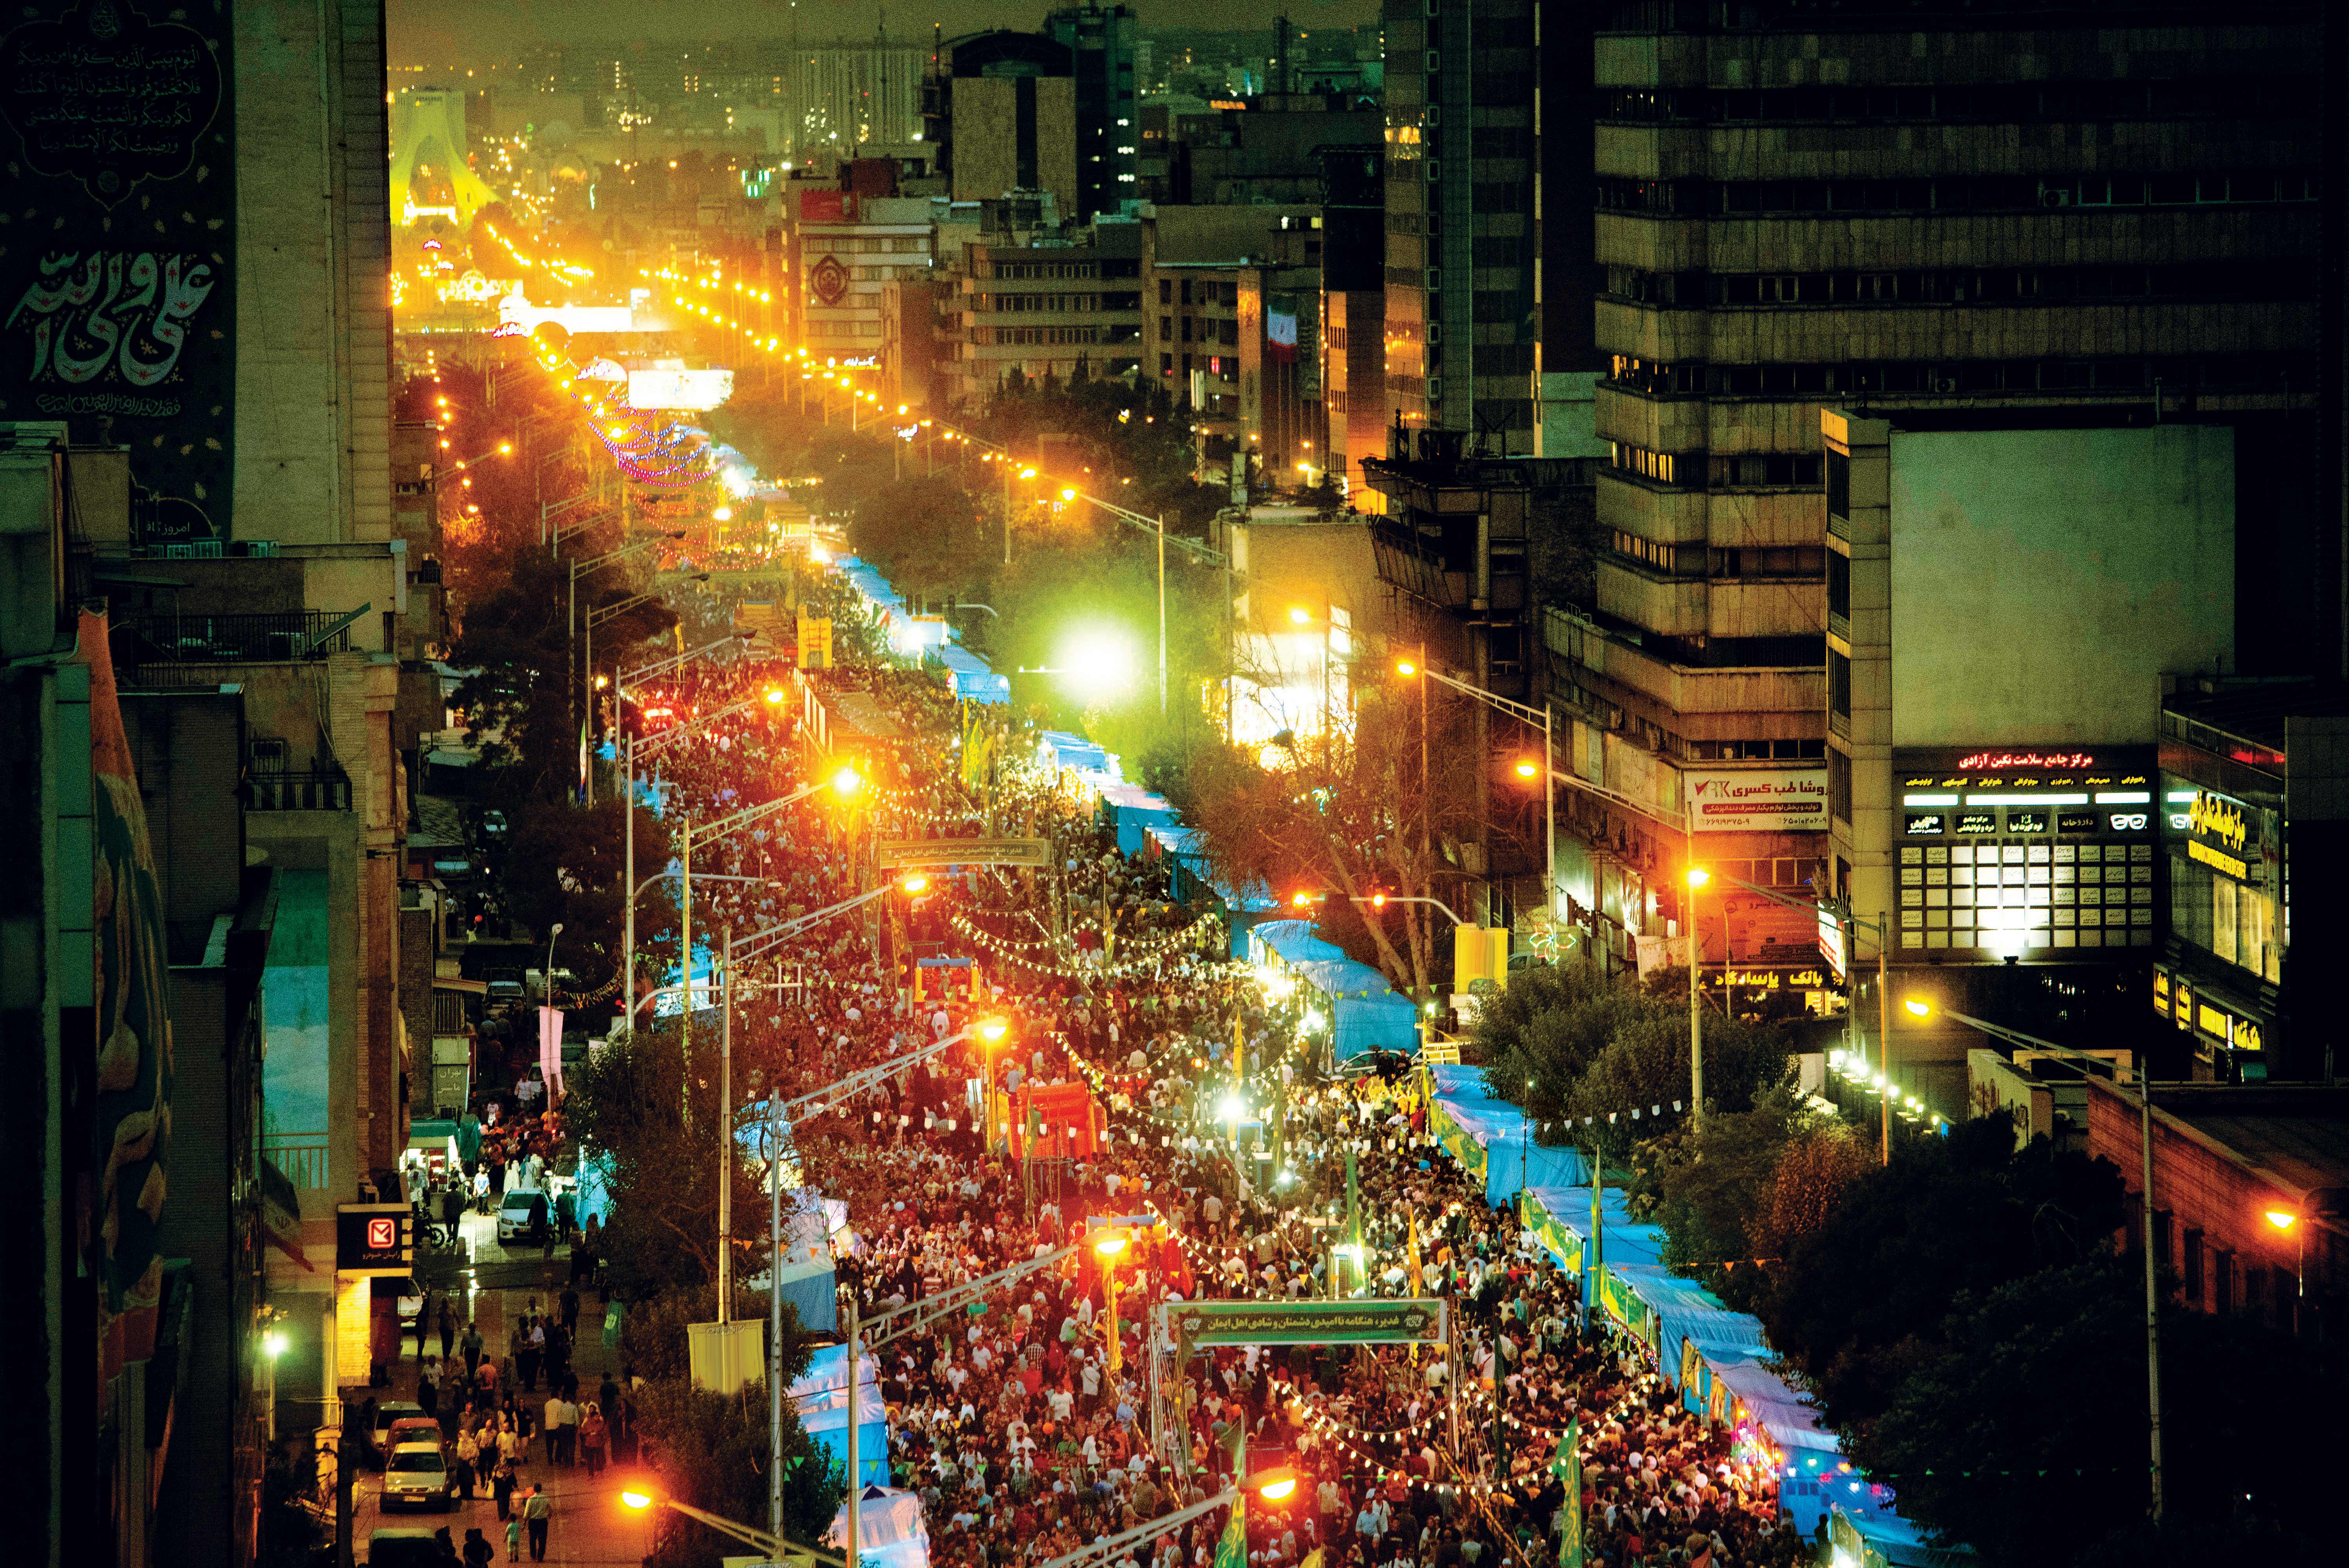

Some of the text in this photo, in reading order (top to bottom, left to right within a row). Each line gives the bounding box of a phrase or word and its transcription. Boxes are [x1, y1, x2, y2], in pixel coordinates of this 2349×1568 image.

[1959, 753, 2092, 768] مرکز جامع سلامت نگین آزادی
[1732, 783, 1771, 797] کسری
[1774, 780, 1797, 796] طب
[2062, 818, 2094, 827] داروخانه
[1715, 970, 1823, 989] بانک پاسارگاد
[1208, 1317, 1231, 1331] ایمان
[1231, 1317, 1248, 1330] اهل
[1248, 1317, 1273, 1329] شادی
[1273, 1320, 1278, 1329] و
[1278, 1316, 1310, 1329] دشمنان
[1345, 1315, 1374, 1326] هنگامه
